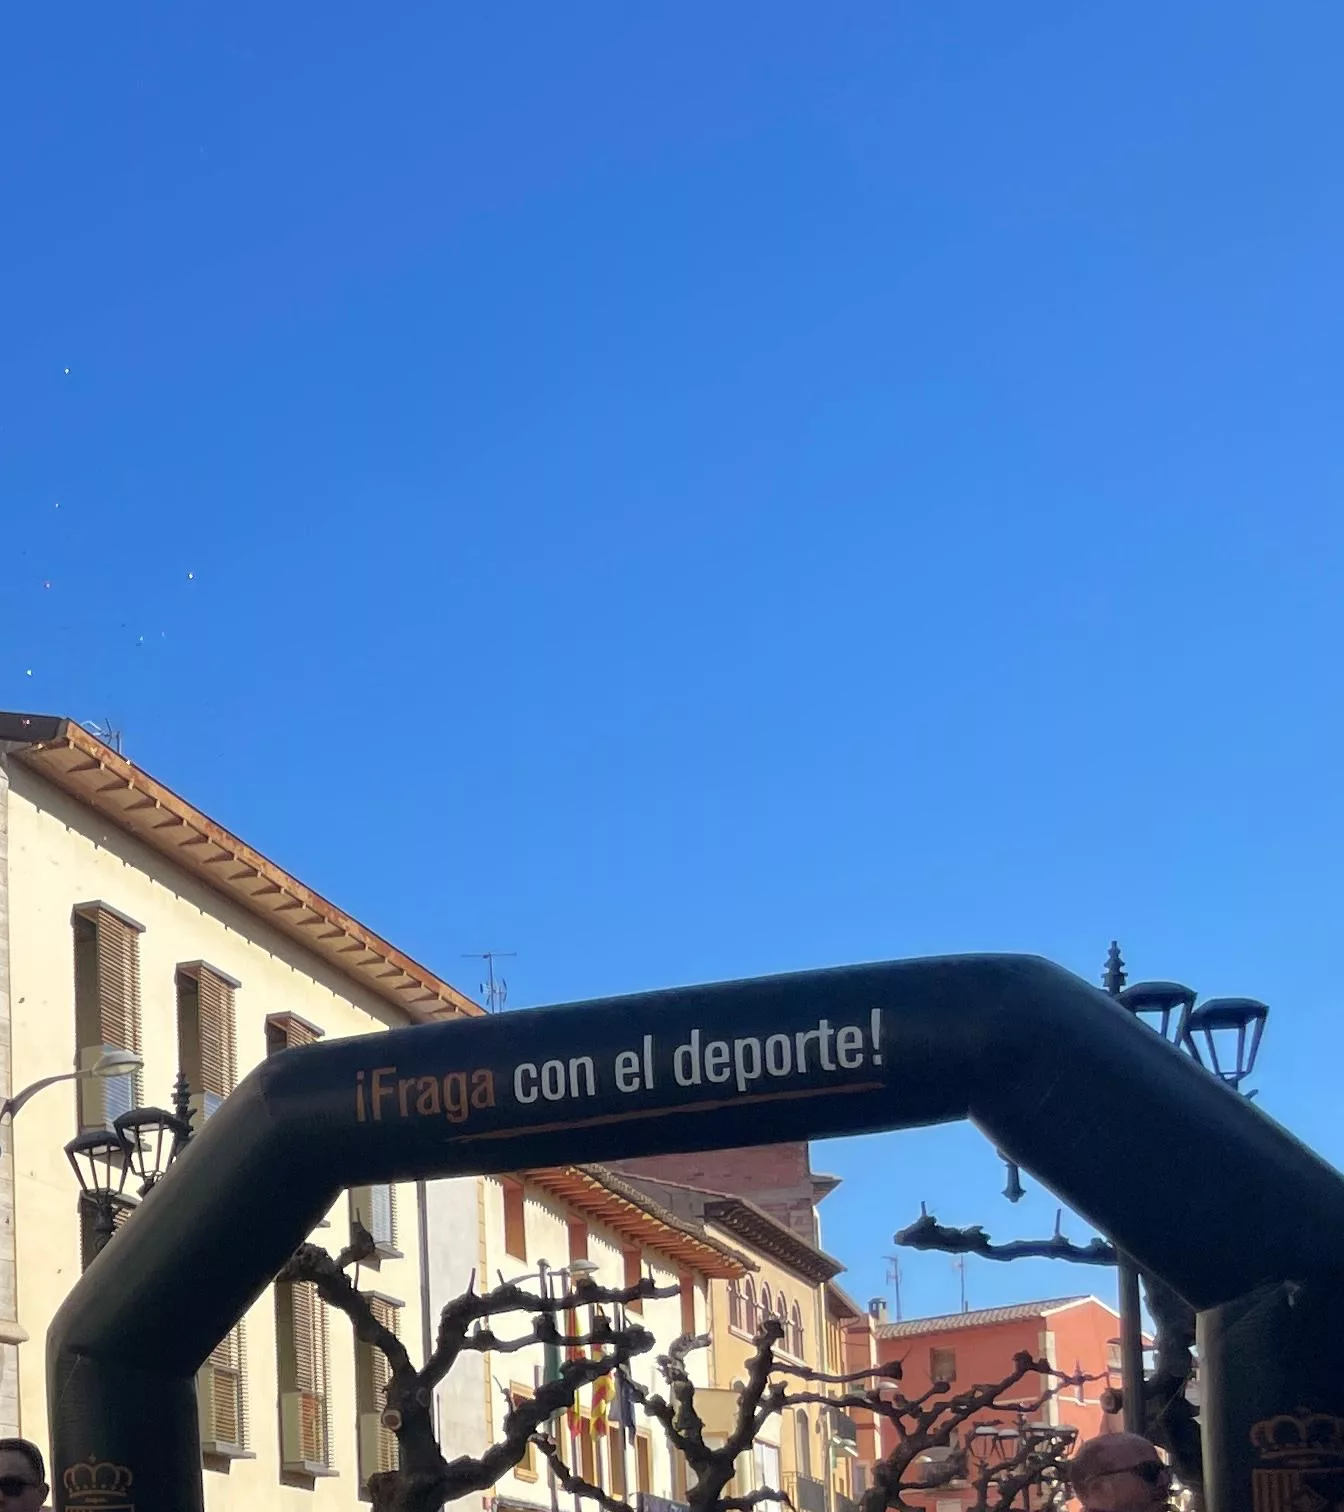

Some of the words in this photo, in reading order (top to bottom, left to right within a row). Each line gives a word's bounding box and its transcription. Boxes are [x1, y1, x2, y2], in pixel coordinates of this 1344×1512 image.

[355, 1067, 496, 1123] ¡Fraga
[514, 1055, 596, 1104] con
[615, 1034, 654, 1093] el
[673, 1008, 883, 1093] deporte!
